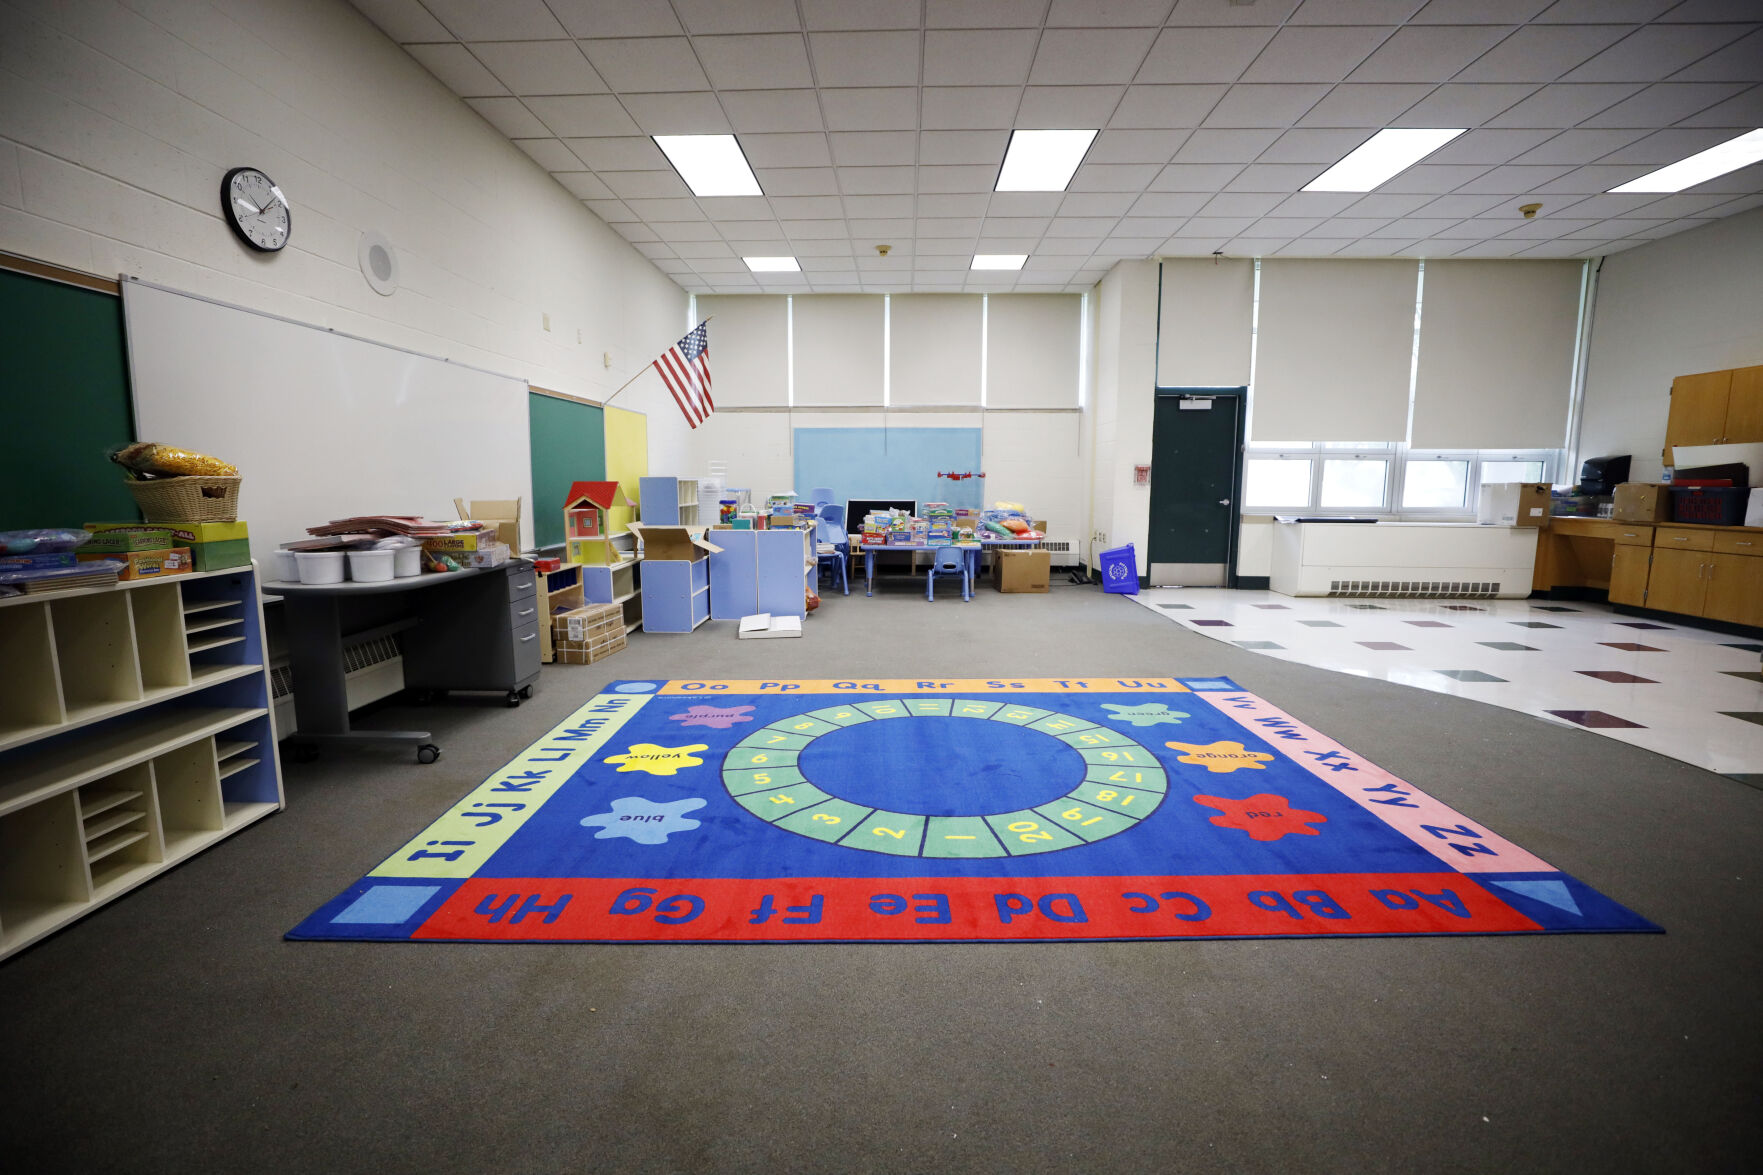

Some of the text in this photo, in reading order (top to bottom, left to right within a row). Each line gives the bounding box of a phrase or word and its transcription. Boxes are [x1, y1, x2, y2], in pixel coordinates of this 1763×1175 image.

[243, 174, 249, 184] 11
[254, 175, 262, 185] 12
[272, 238, 278, 247] 5
[426, 540, 443, 548] 400
[681, 680, 1169, 692] Oo Pp Qq Rr Ss Tt Uu
[871, 705, 897, 714] 10
[919, 703, 939, 711] 11
[962, 704, 987, 713] 12
[685, 712, 737, 721] purple
[836, 712, 852, 720] 9
[1007, 710, 1033, 720] 13
[793, 721, 815, 730] 8
[1047, 719, 1075, 730] 14
[767, 735, 788, 744] 7
[1079, 733, 1111, 745] 15
[624, 752, 681, 761] yellow
[751, 753, 769, 764] 6
[1101, 751, 1135, 761] 16
[1195, 750, 1260, 761] orange
[407, 697, 630, 863] Ii Jj Kk Ll Mm Nn
[753, 773, 772, 785] 5
[1108, 770, 1143, 784] 17
[1222, 696, 1499, 857] Vv Ww Xx Yy Zz
[768, 793, 796, 805] 4
[1095, 789, 1136, 807] 18
[620, 813, 666, 824] blue
[811, 813, 842, 825] 3
[1061, 807, 1103, 827] 19
[1245, 810, 1283, 820] red
[871, 826, 907, 840] 2
[1007, 821, 1054, 844] 20
[474, 887, 1472, 925] Aa Bb Cc Dd Ee Ff Gg Hh
